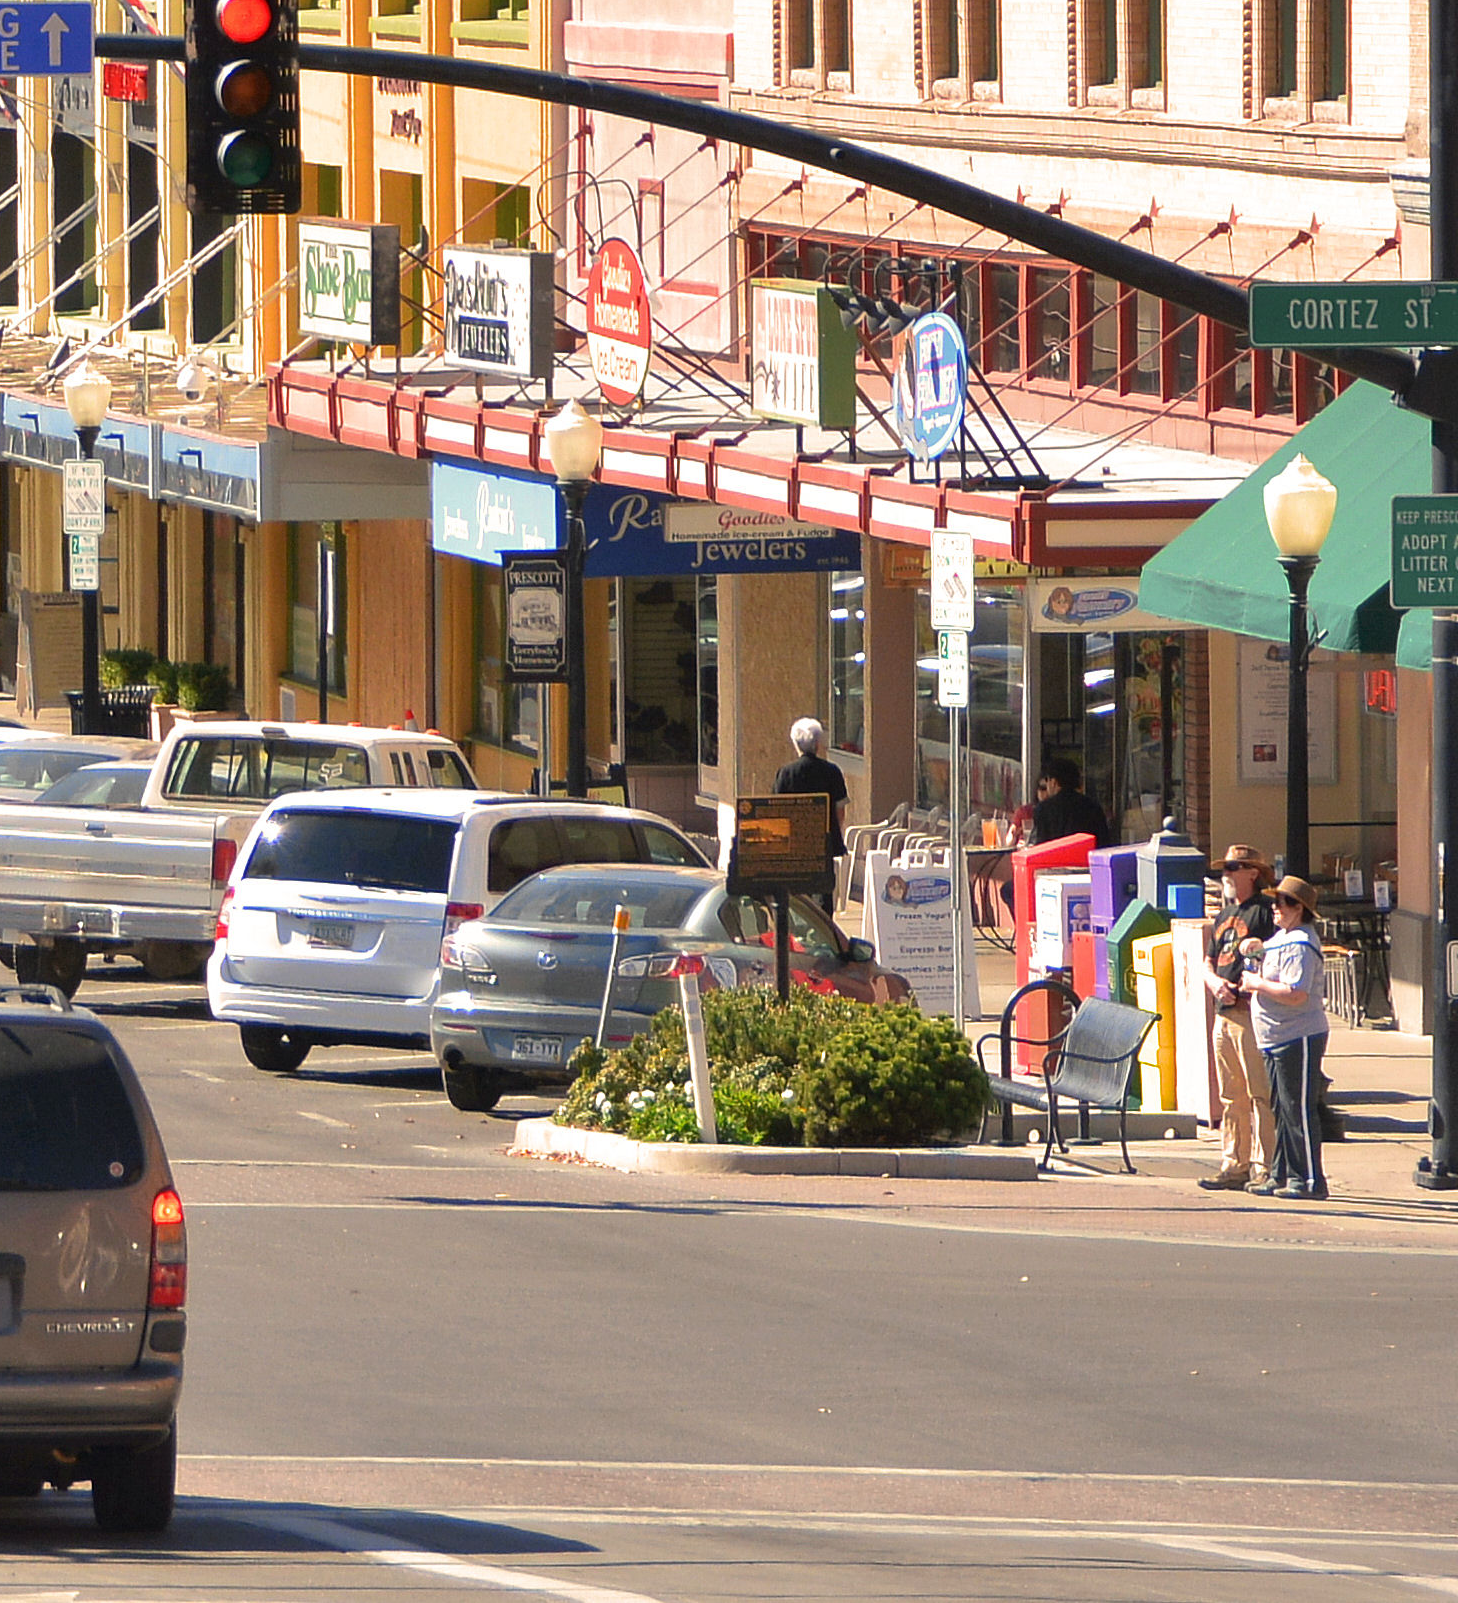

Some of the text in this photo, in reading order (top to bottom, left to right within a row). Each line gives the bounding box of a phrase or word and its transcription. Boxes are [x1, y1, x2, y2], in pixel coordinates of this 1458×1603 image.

[305, 245, 341, 319] Shoe
[594, 292, 639, 336] Homemade
[1289, 299, 1378, 329] CORTEZ
[596, 342, 637, 382] Ice Cream
[717, 509, 784, 529] Goodies
[1396, 511, 1420, 524] KEEP
[671, 530, 731, 540] Homemade
[787, 529, 795, 538] &
[1401, 534, 1447, 550] ADOPT
[691, 539, 806, 569] Jewelers
[1401, 556, 1448, 572] LITTER
[509, 571, 561, 584] PRESCOTT
[1417, 577, 1455, 593] NEXT
[894, 912, 951, 921] Frozen Yogurt
[45, 1321, 136, 1335] CHEVROLET
